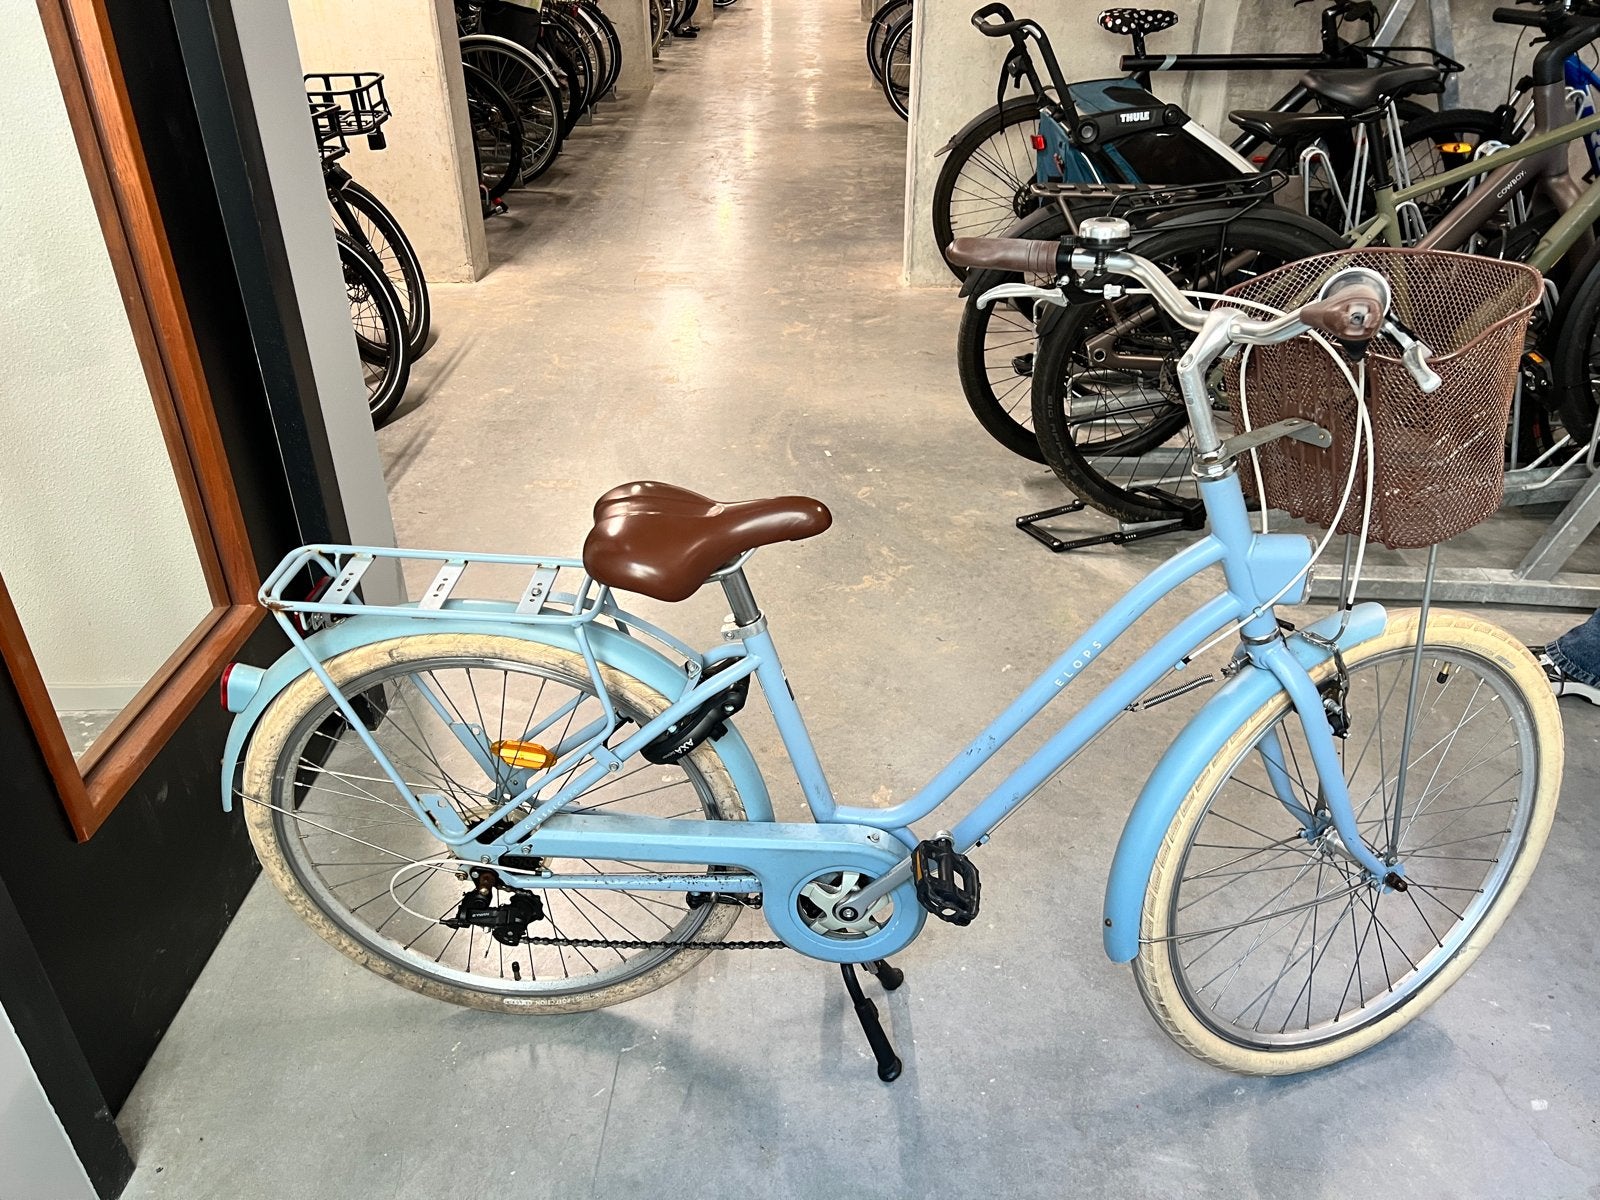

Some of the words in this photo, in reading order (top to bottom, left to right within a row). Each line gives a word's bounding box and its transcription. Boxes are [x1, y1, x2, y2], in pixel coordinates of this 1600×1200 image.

[1120, 111, 1150, 122] THULE
[1054, 640, 1102, 687] ELOPS
[674, 738, 694, 754] AXA
[524, 801, 563, 830] CLASSIC
